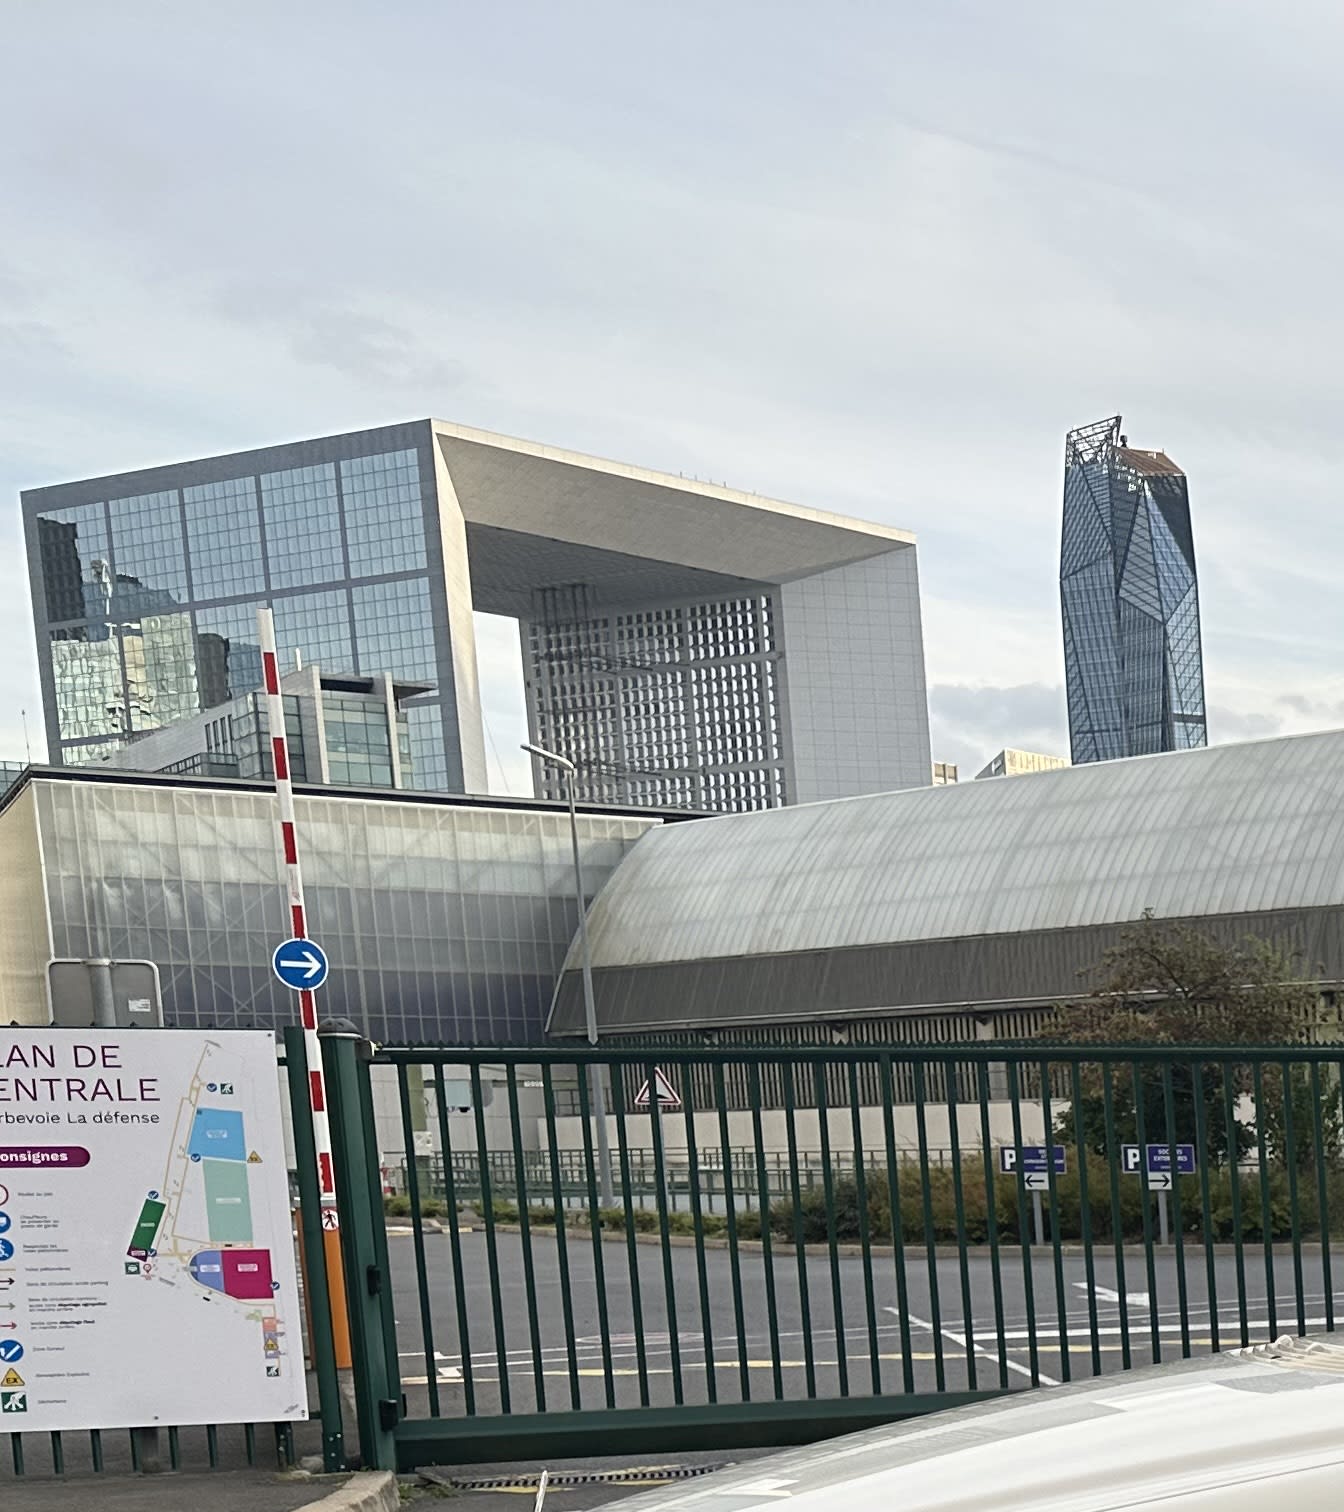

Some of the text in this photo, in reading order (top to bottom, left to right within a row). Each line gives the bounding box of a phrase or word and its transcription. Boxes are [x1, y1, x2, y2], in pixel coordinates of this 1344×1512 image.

[73, 1045, 122, 1068] DE
[67, 1112, 88, 1124] La
[92, 1111, 160, 1124] défense
[0, 1151, 69, 1164] onsignes
